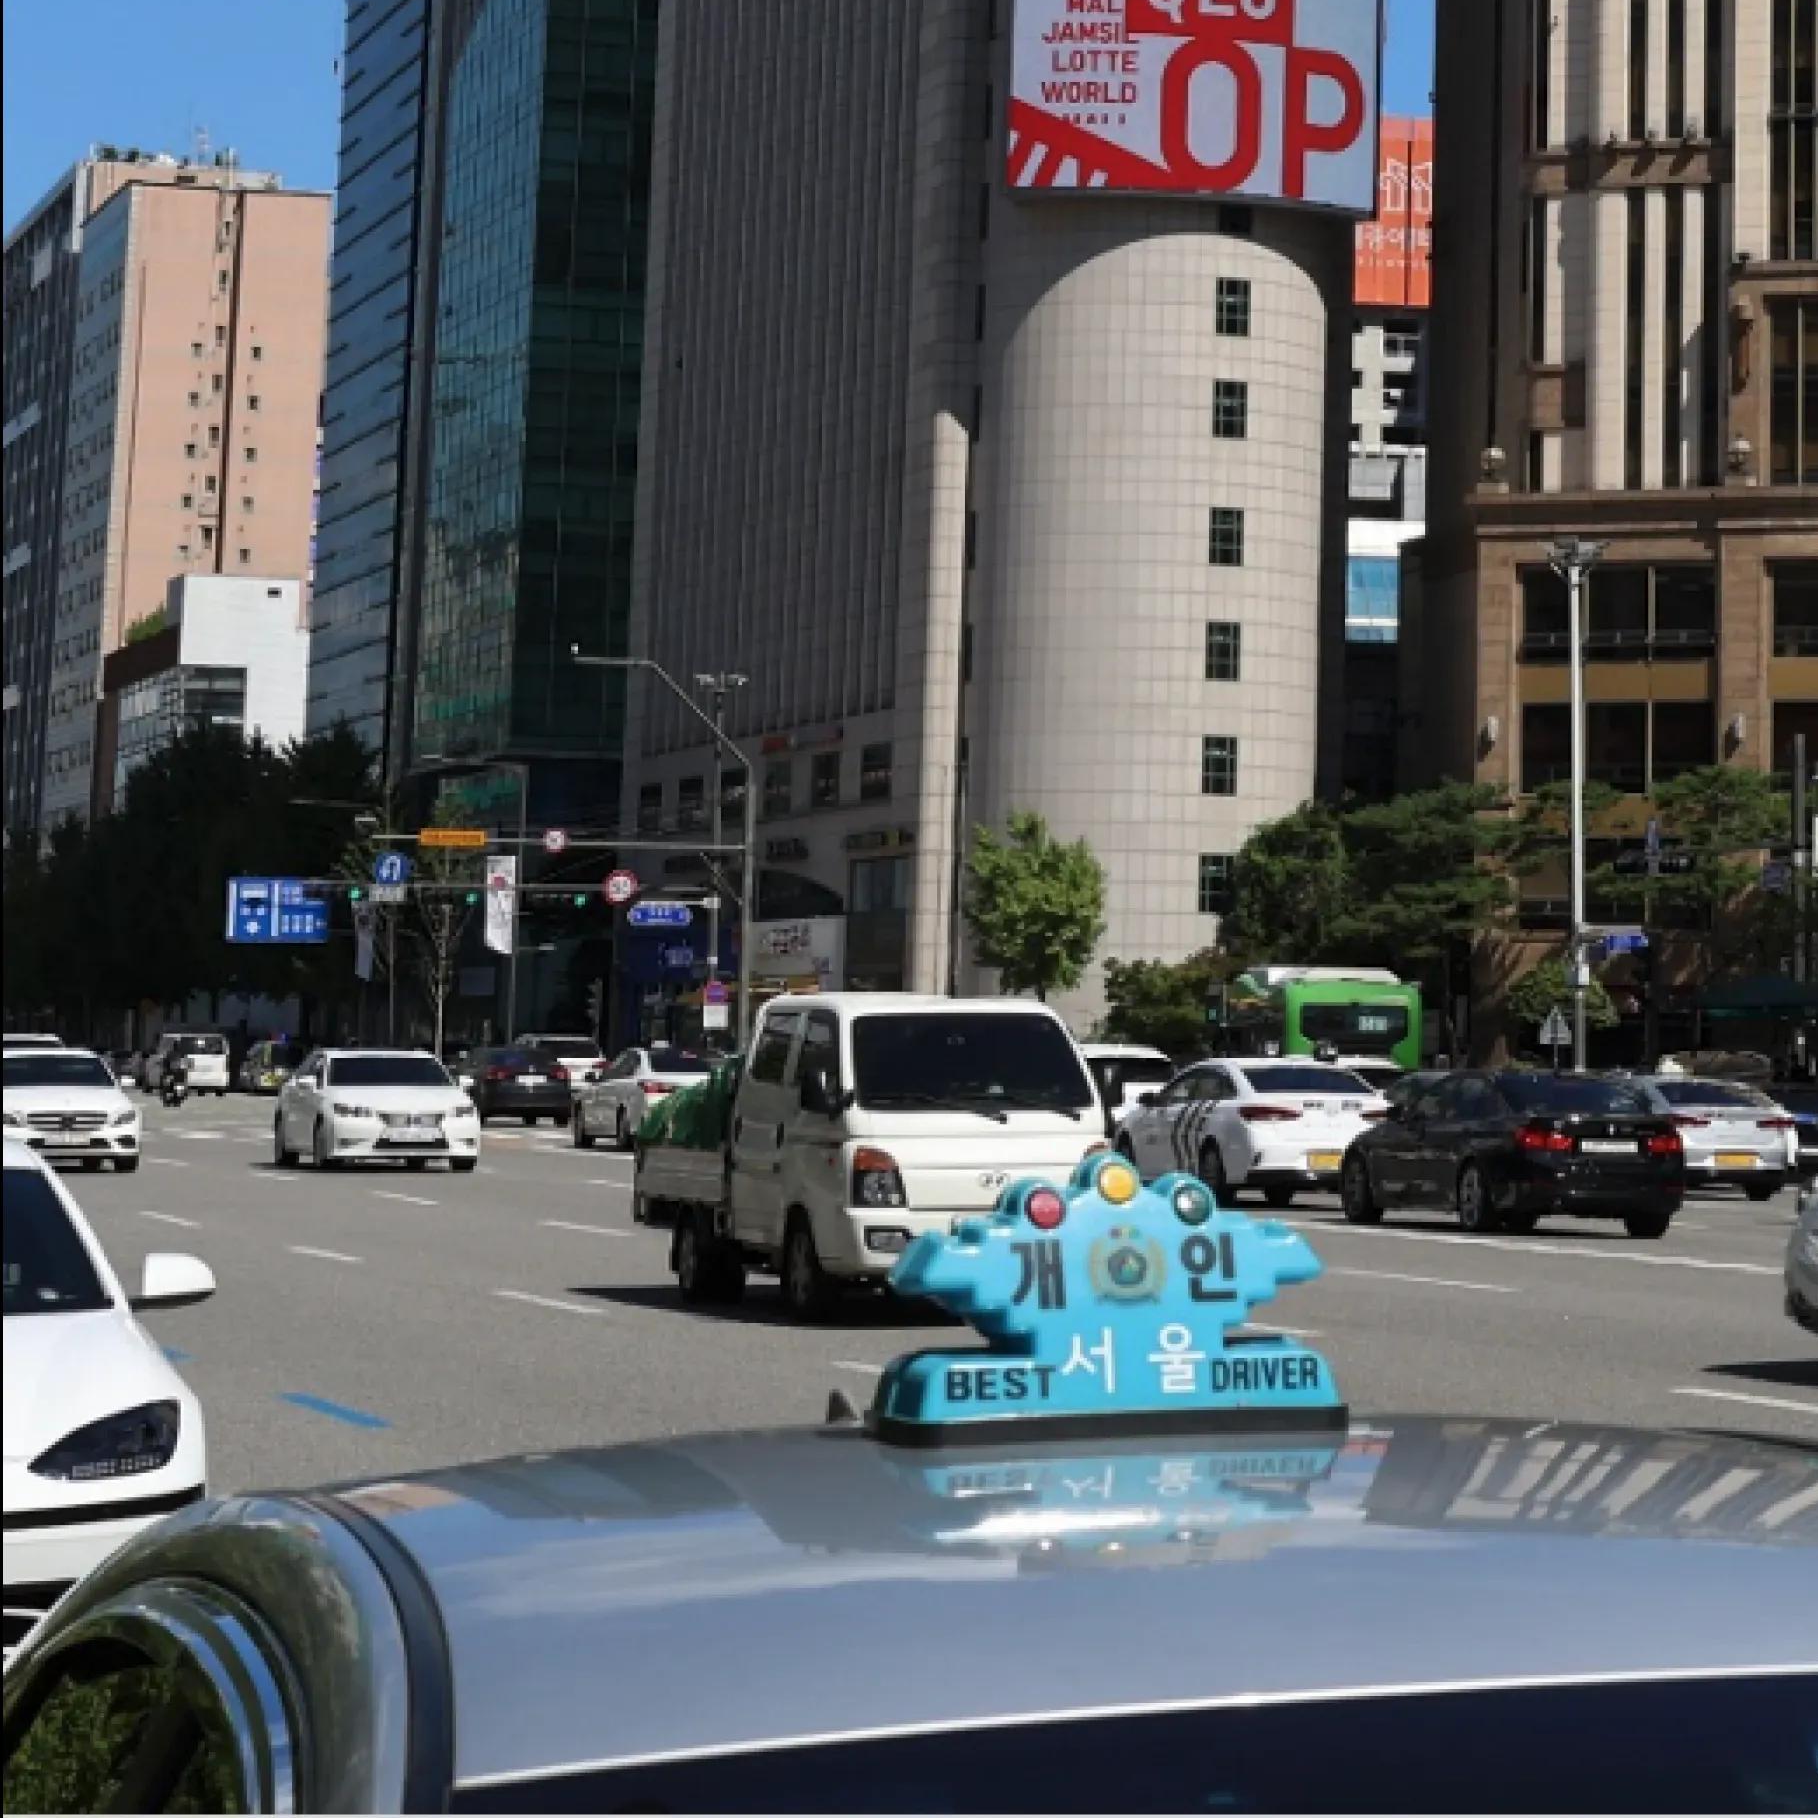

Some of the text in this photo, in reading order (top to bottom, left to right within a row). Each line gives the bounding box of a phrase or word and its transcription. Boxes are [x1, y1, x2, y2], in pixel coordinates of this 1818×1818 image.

[1041, 22, 1140, 44] JAMSIL
[1051, 50, 1140, 72] LOTTE
[1041, 81, 1137, 103] WORLD
[946, 1365, 1057, 1402] BEST
[1210, 1356, 1321, 1392] DRIVER
